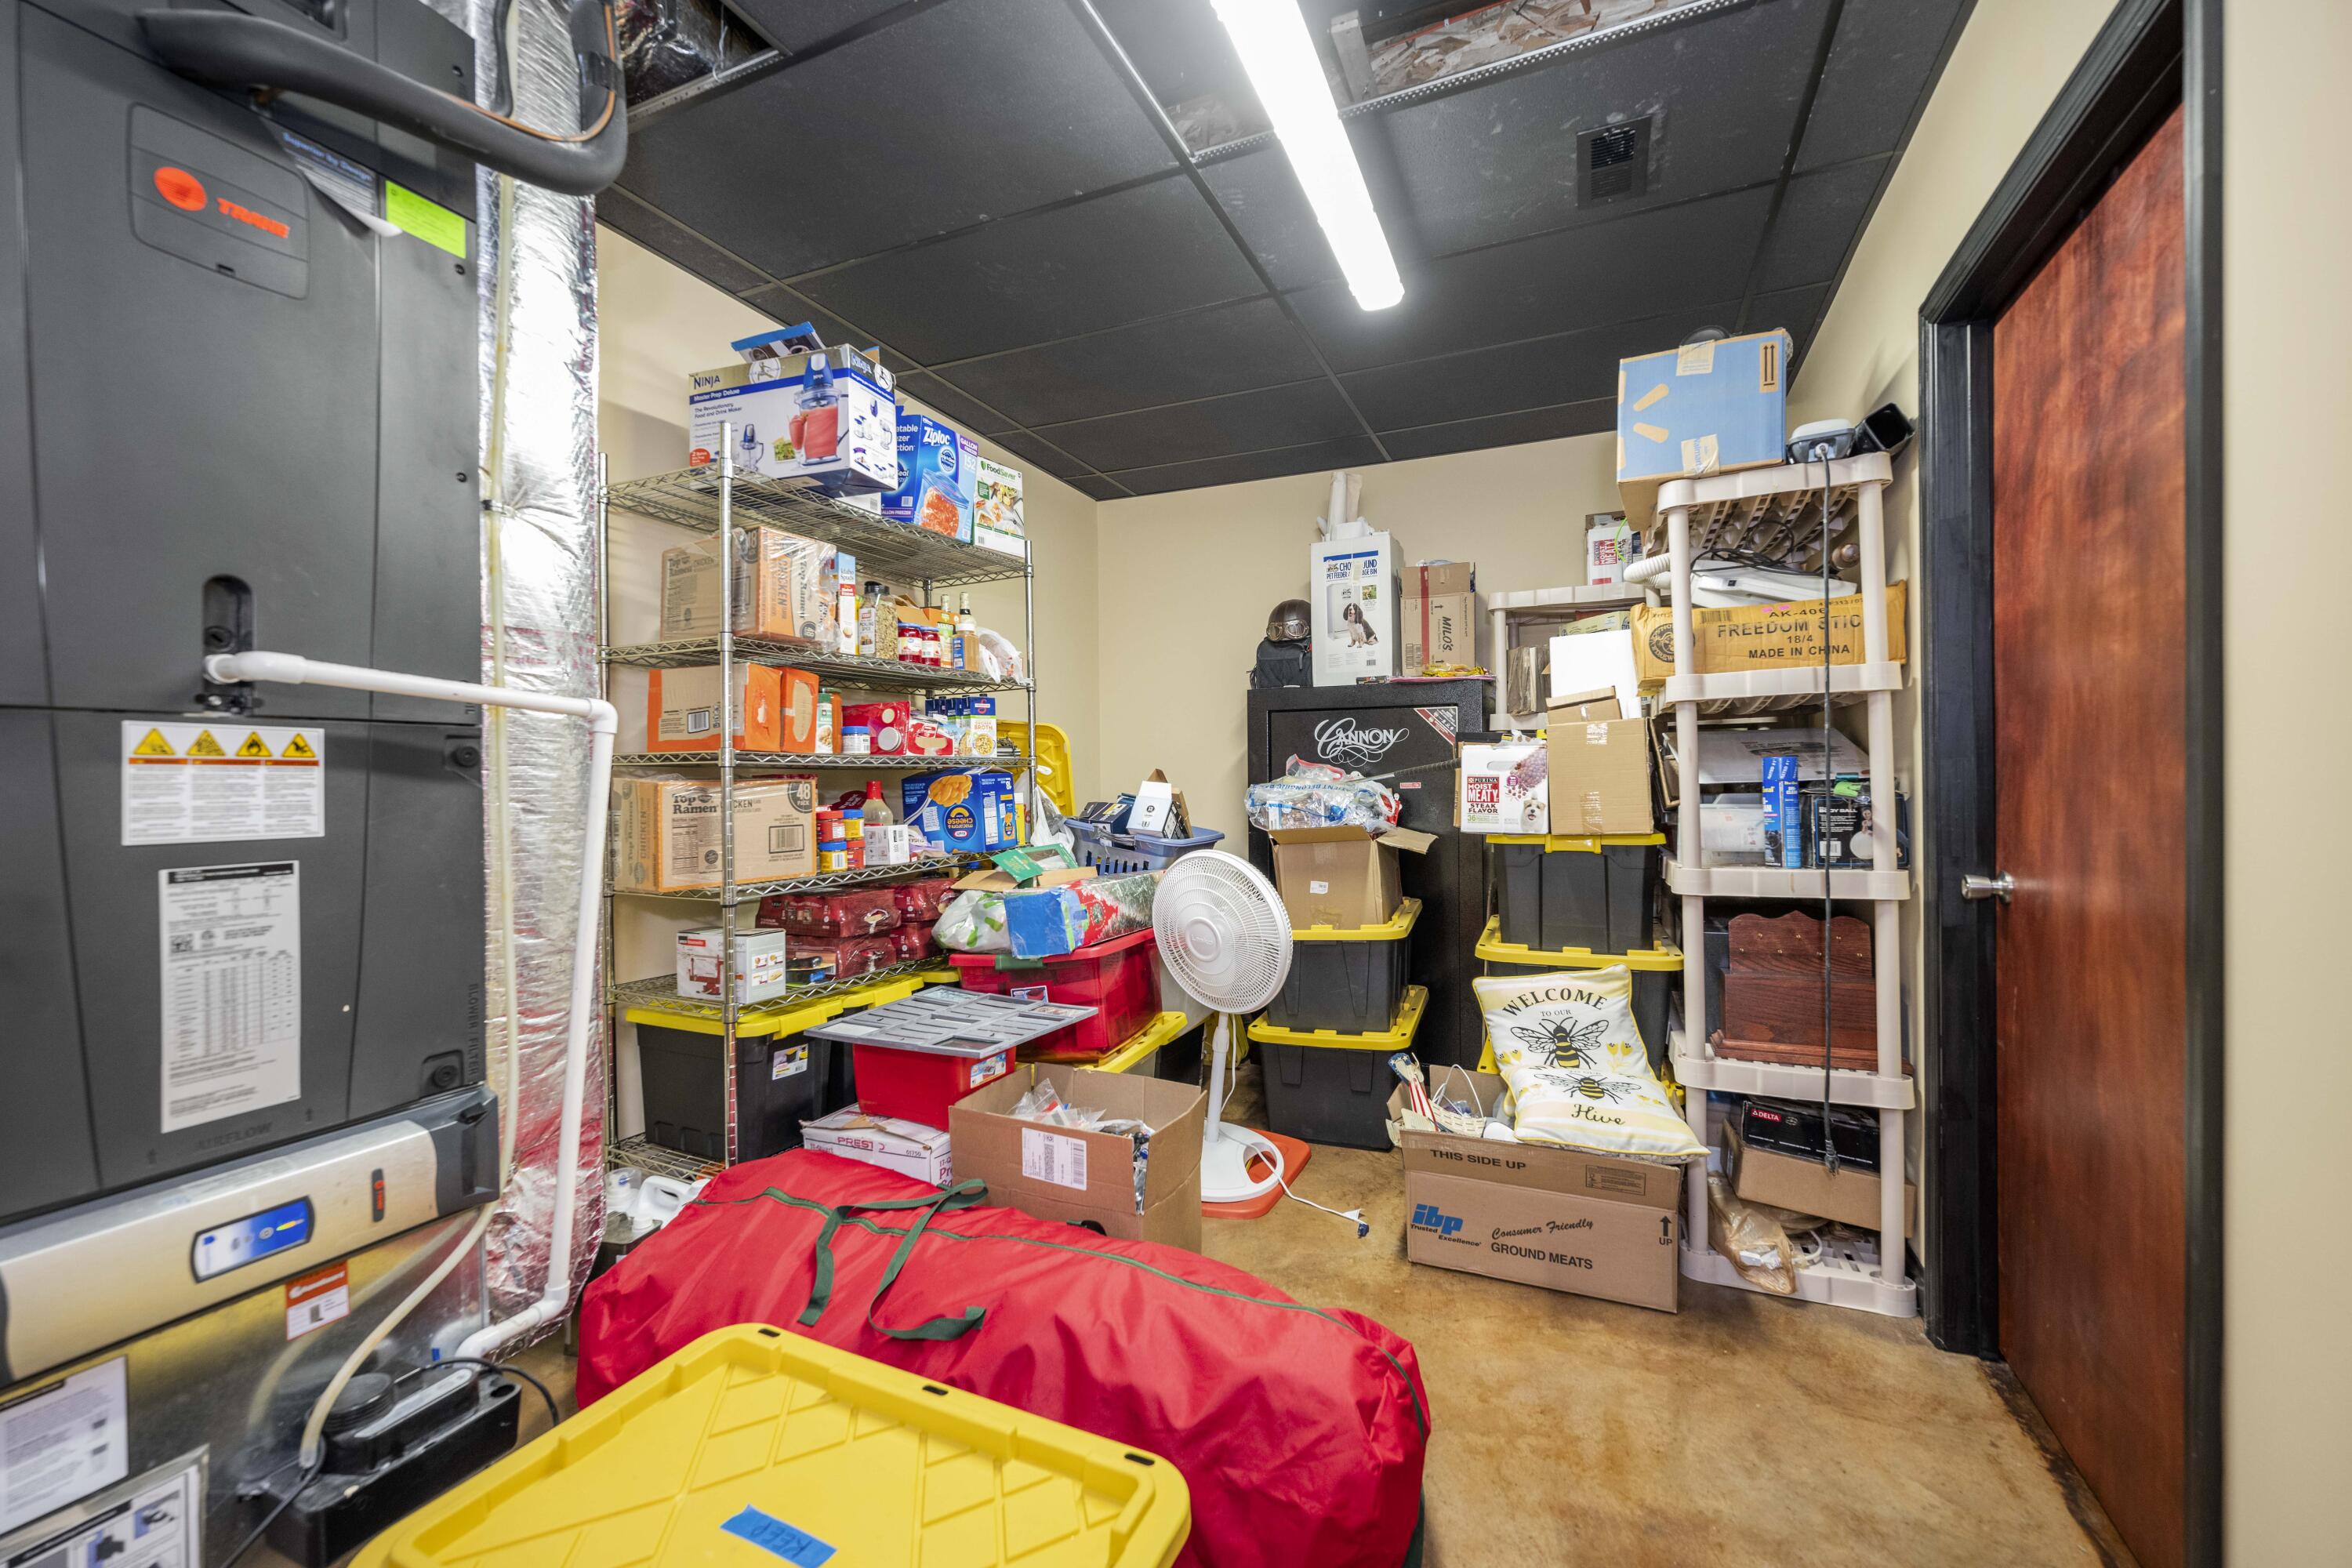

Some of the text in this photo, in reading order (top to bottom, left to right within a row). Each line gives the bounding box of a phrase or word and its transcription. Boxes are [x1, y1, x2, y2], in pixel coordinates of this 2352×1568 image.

[216, 198, 291, 239] TRANE
[694, 375, 720, 390] NINJA
[710, 390, 722, 399] Prep
[923, 426, 951, 447] Ziploc
[960, 437, 978, 451] GALLON
[964, 454, 977, 470] 152
[986, 463, 1017, 481] FoodSaver
[1605, 539, 1617, 564] MEATY
[777, 559, 789, 606] CHICKEN
[1443, 616, 1454, 652] MILO'S
[1718, 619, 1809, 638] FREEDOM
[1787, 633, 1813, 644] 18/4
[1748, 644, 1850, 659] MADE IN CHNA
[672, 794, 697, 806] Top
[797, 783, 811, 800] 48
[1468, 789, 1498, 802] MEATY
[672, 804, 717, 815] Ramen
[1502, 988, 1608, 1017] WELCOME
[1571, 1103, 1626, 1125] Hive
[1758, 1111, 1780, 1121] DELTA
[1430, 1149, 1526, 1170] THIS SIDE UP
[1412, 1203, 1464, 1236] ibp
[1410, 1223, 1438, 1234] Trusted
[1491, 1218, 1594, 1240] Consumer Friendly
[1438, 1234, 1481, 1247] Excellence
[1658, 1237, 1673, 1247] UP
[1490, 1242, 1593, 1269] GROUND MEATS
[750, 1520, 813, 1560] KEEP
